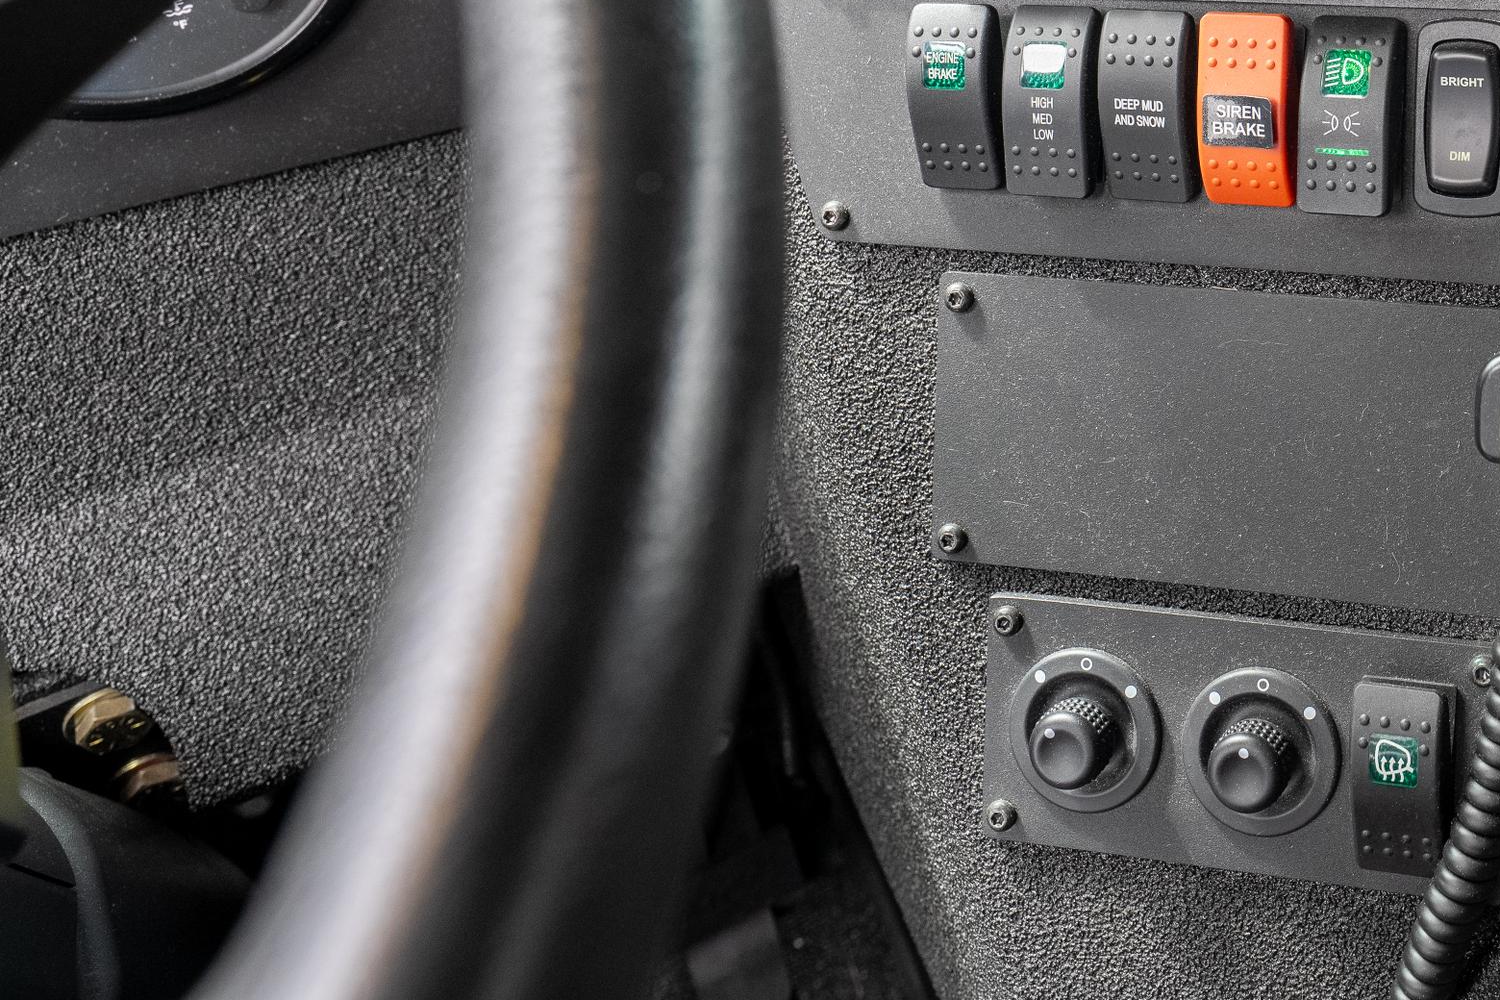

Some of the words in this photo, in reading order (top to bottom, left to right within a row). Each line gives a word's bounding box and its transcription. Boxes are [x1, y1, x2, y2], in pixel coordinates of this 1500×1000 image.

[926, 51, 960, 65] ENGINE
[928, 67, 958, 81] BRAKE
[1440, 76, 1485, 88] BRIGHT
[1031, 97, 1054, 110] HIGH
[1114, 98, 1139, 111] DEEP
[1141, 100, 1164, 112] MUD
[1032, 113, 1053, 125] MED
[1216, 105, 1261, 120] SIREN
[1114, 114, 1134, 126] AND
[1136, 115, 1165, 128] SNOW
[1033, 128, 1054, 141] LOW
[1212, 122, 1265, 137] BRAKE
[1450, 151, 1471, 162] DIM
